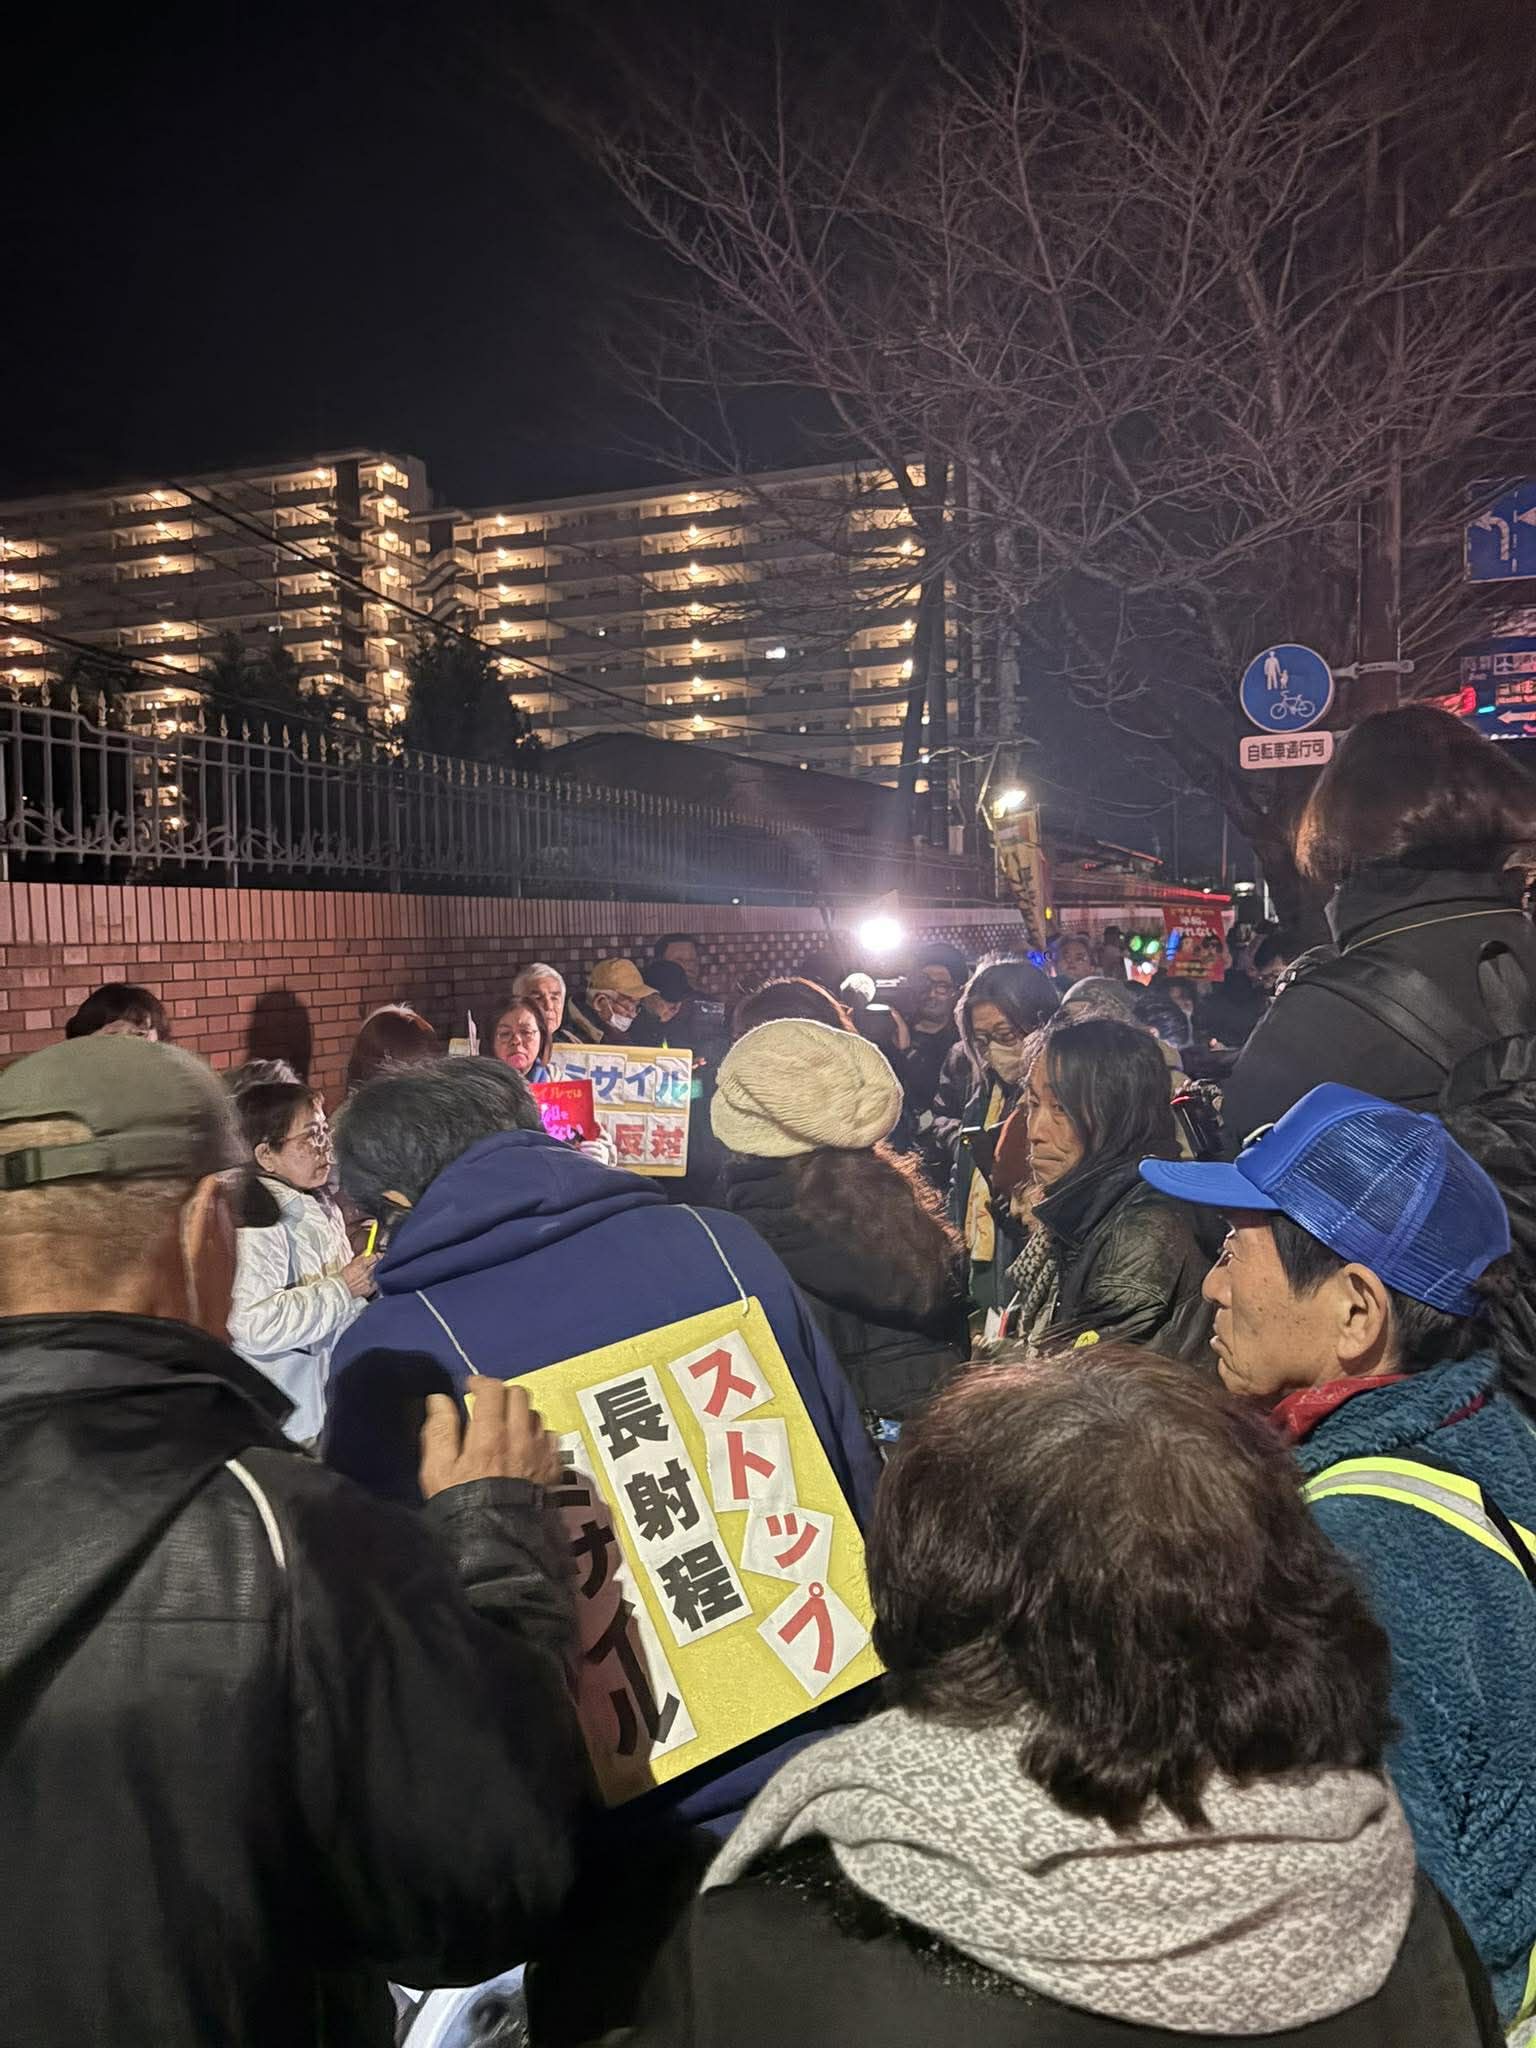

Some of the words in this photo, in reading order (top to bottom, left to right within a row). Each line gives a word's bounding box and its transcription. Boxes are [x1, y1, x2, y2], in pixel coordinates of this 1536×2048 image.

[1247, 738, 1325, 762] 自転車通行可
[565, 1063, 688, 1101] ミサイル
[615, 1123, 684, 1158] 反対
[593, 1375, 743, 1632] 長射程
[688, 1347, 835, 1675] ストップ
